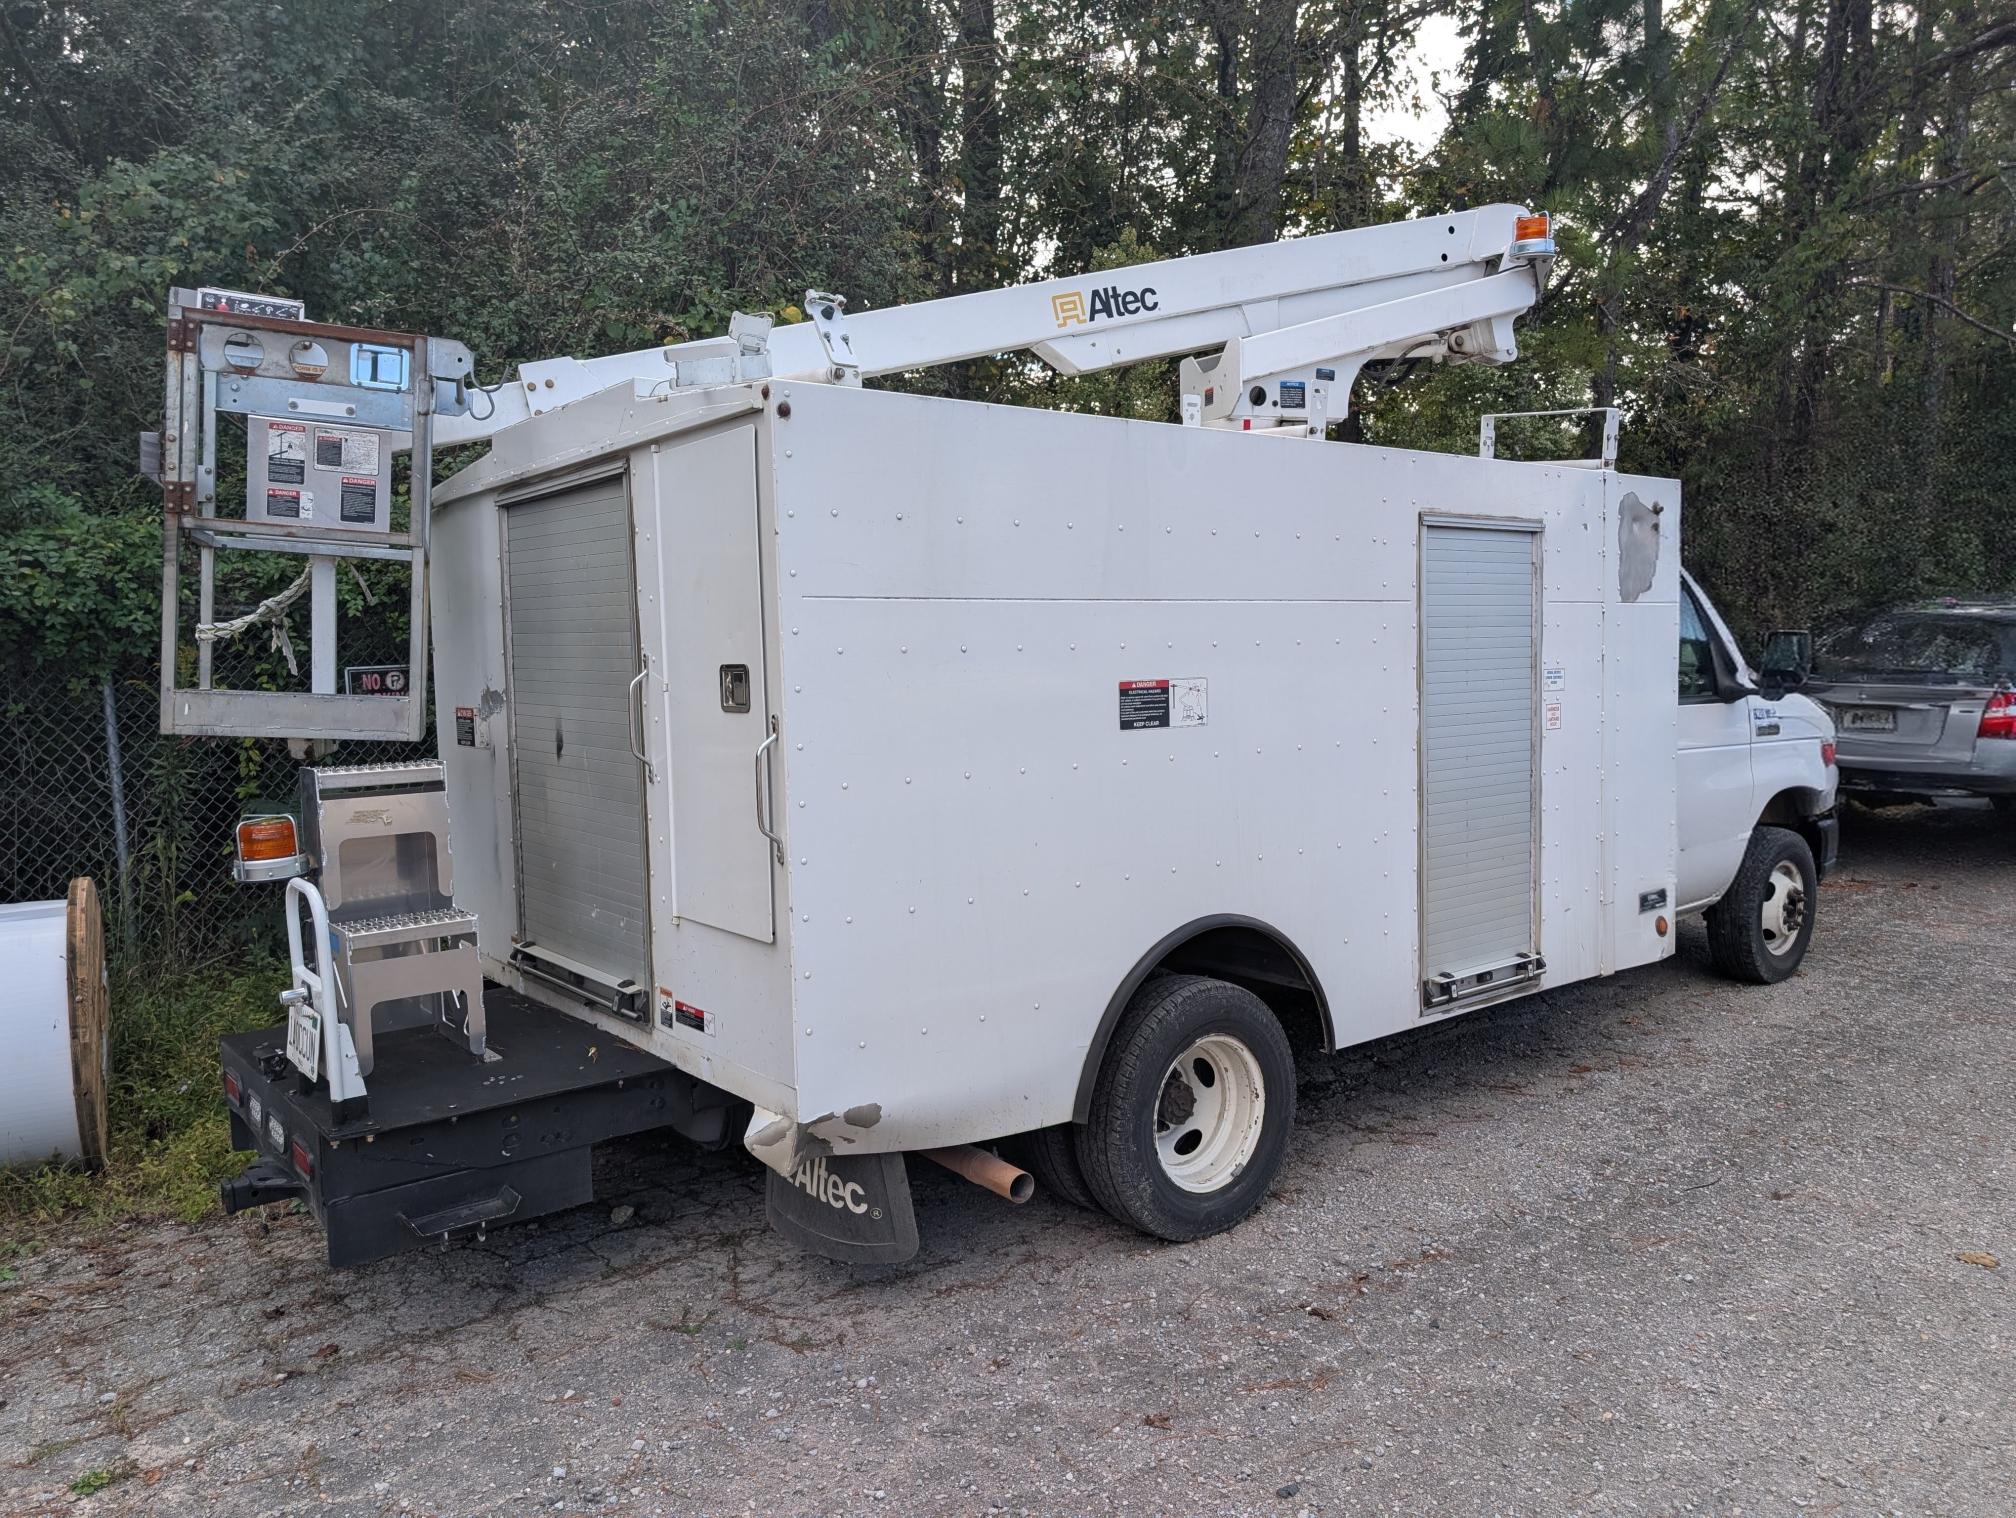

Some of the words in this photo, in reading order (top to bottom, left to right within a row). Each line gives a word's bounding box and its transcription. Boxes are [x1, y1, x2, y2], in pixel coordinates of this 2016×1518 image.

[1089, 286, 1159, 322] Altec
[278, 424, 304, 432] DANGER
[362, 673, 381, 690] NO
[795, 1155, 868, 1214] Altec
